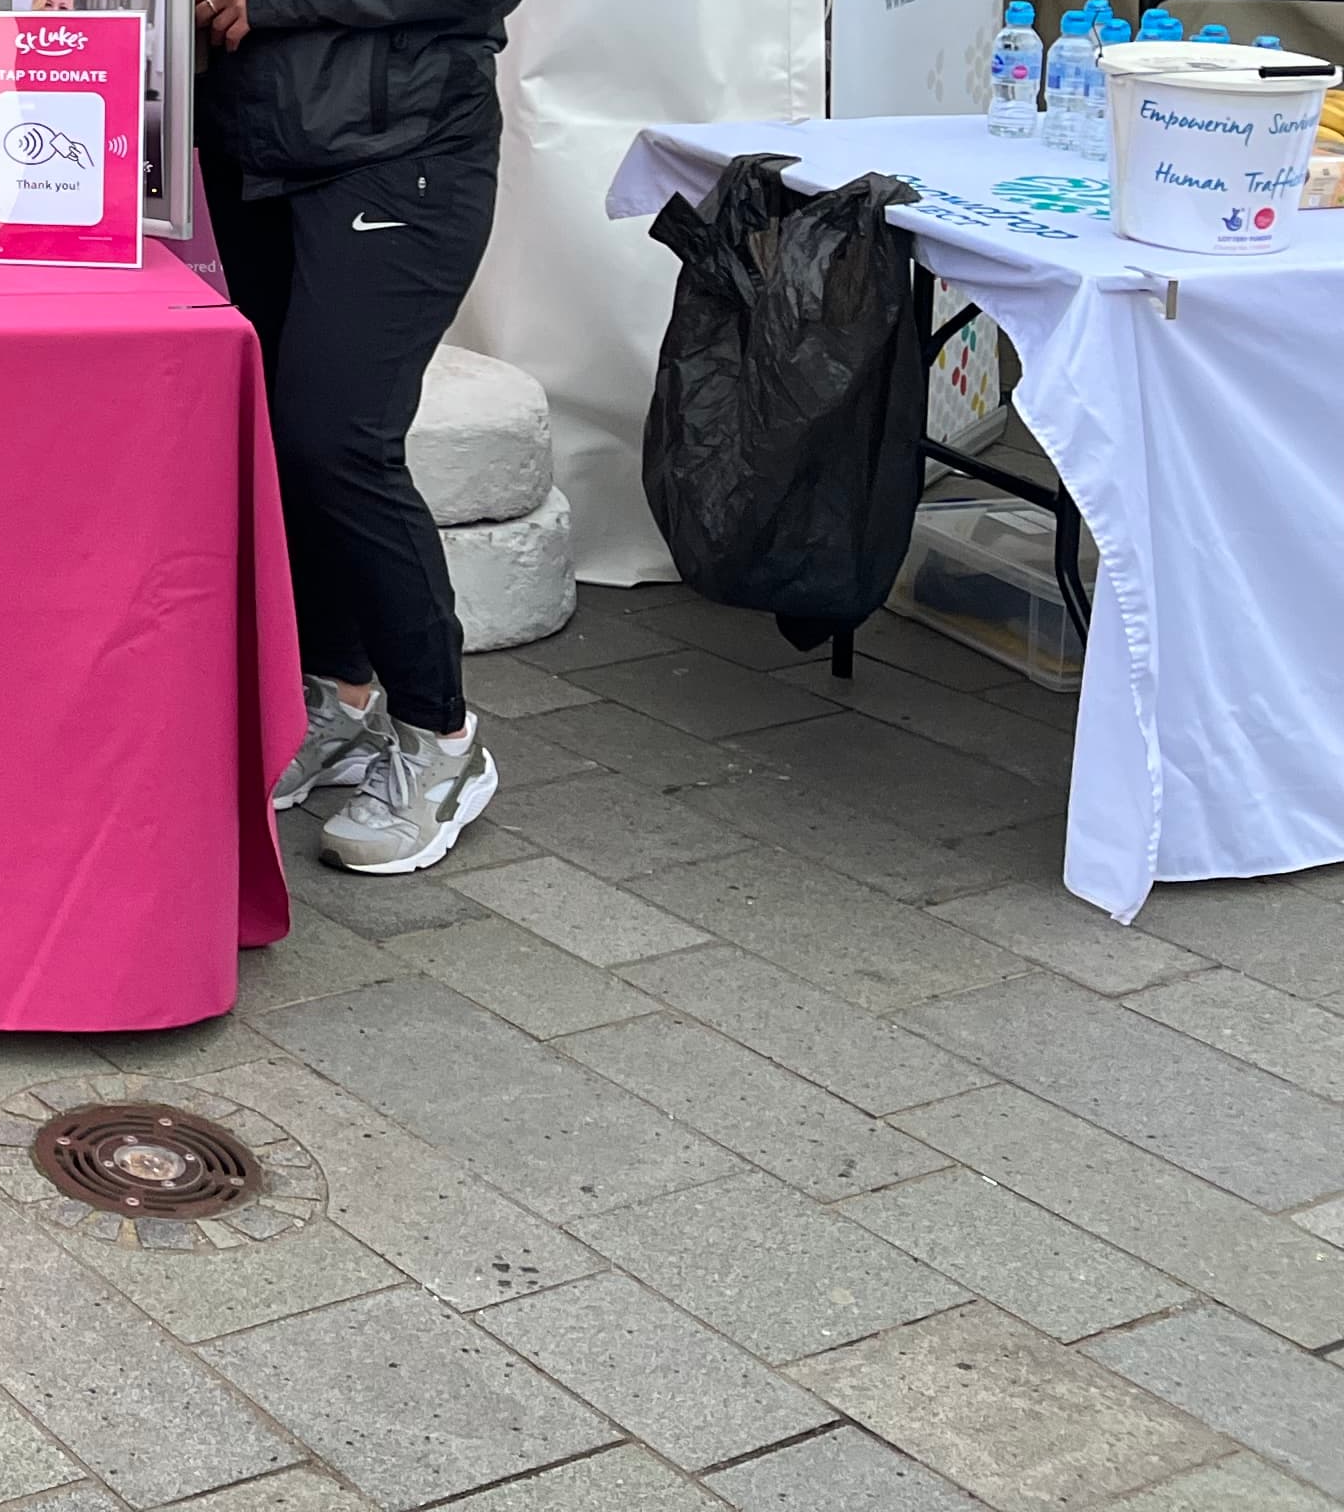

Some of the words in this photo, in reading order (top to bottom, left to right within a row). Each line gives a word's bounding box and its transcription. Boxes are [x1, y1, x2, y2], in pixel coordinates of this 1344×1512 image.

[15, 32, 38, 55] St
[39, 26, 89, 51] Luke's
[27, 69, 47, 82] TO
[49, 69, 109, 84] DONATE
[1140, 99, 1255, 147] Empowering
[16, 179, 53, 191] Thank
[55, 180, 81, 193] you!
[1155, 161, 1229, 193] Human
